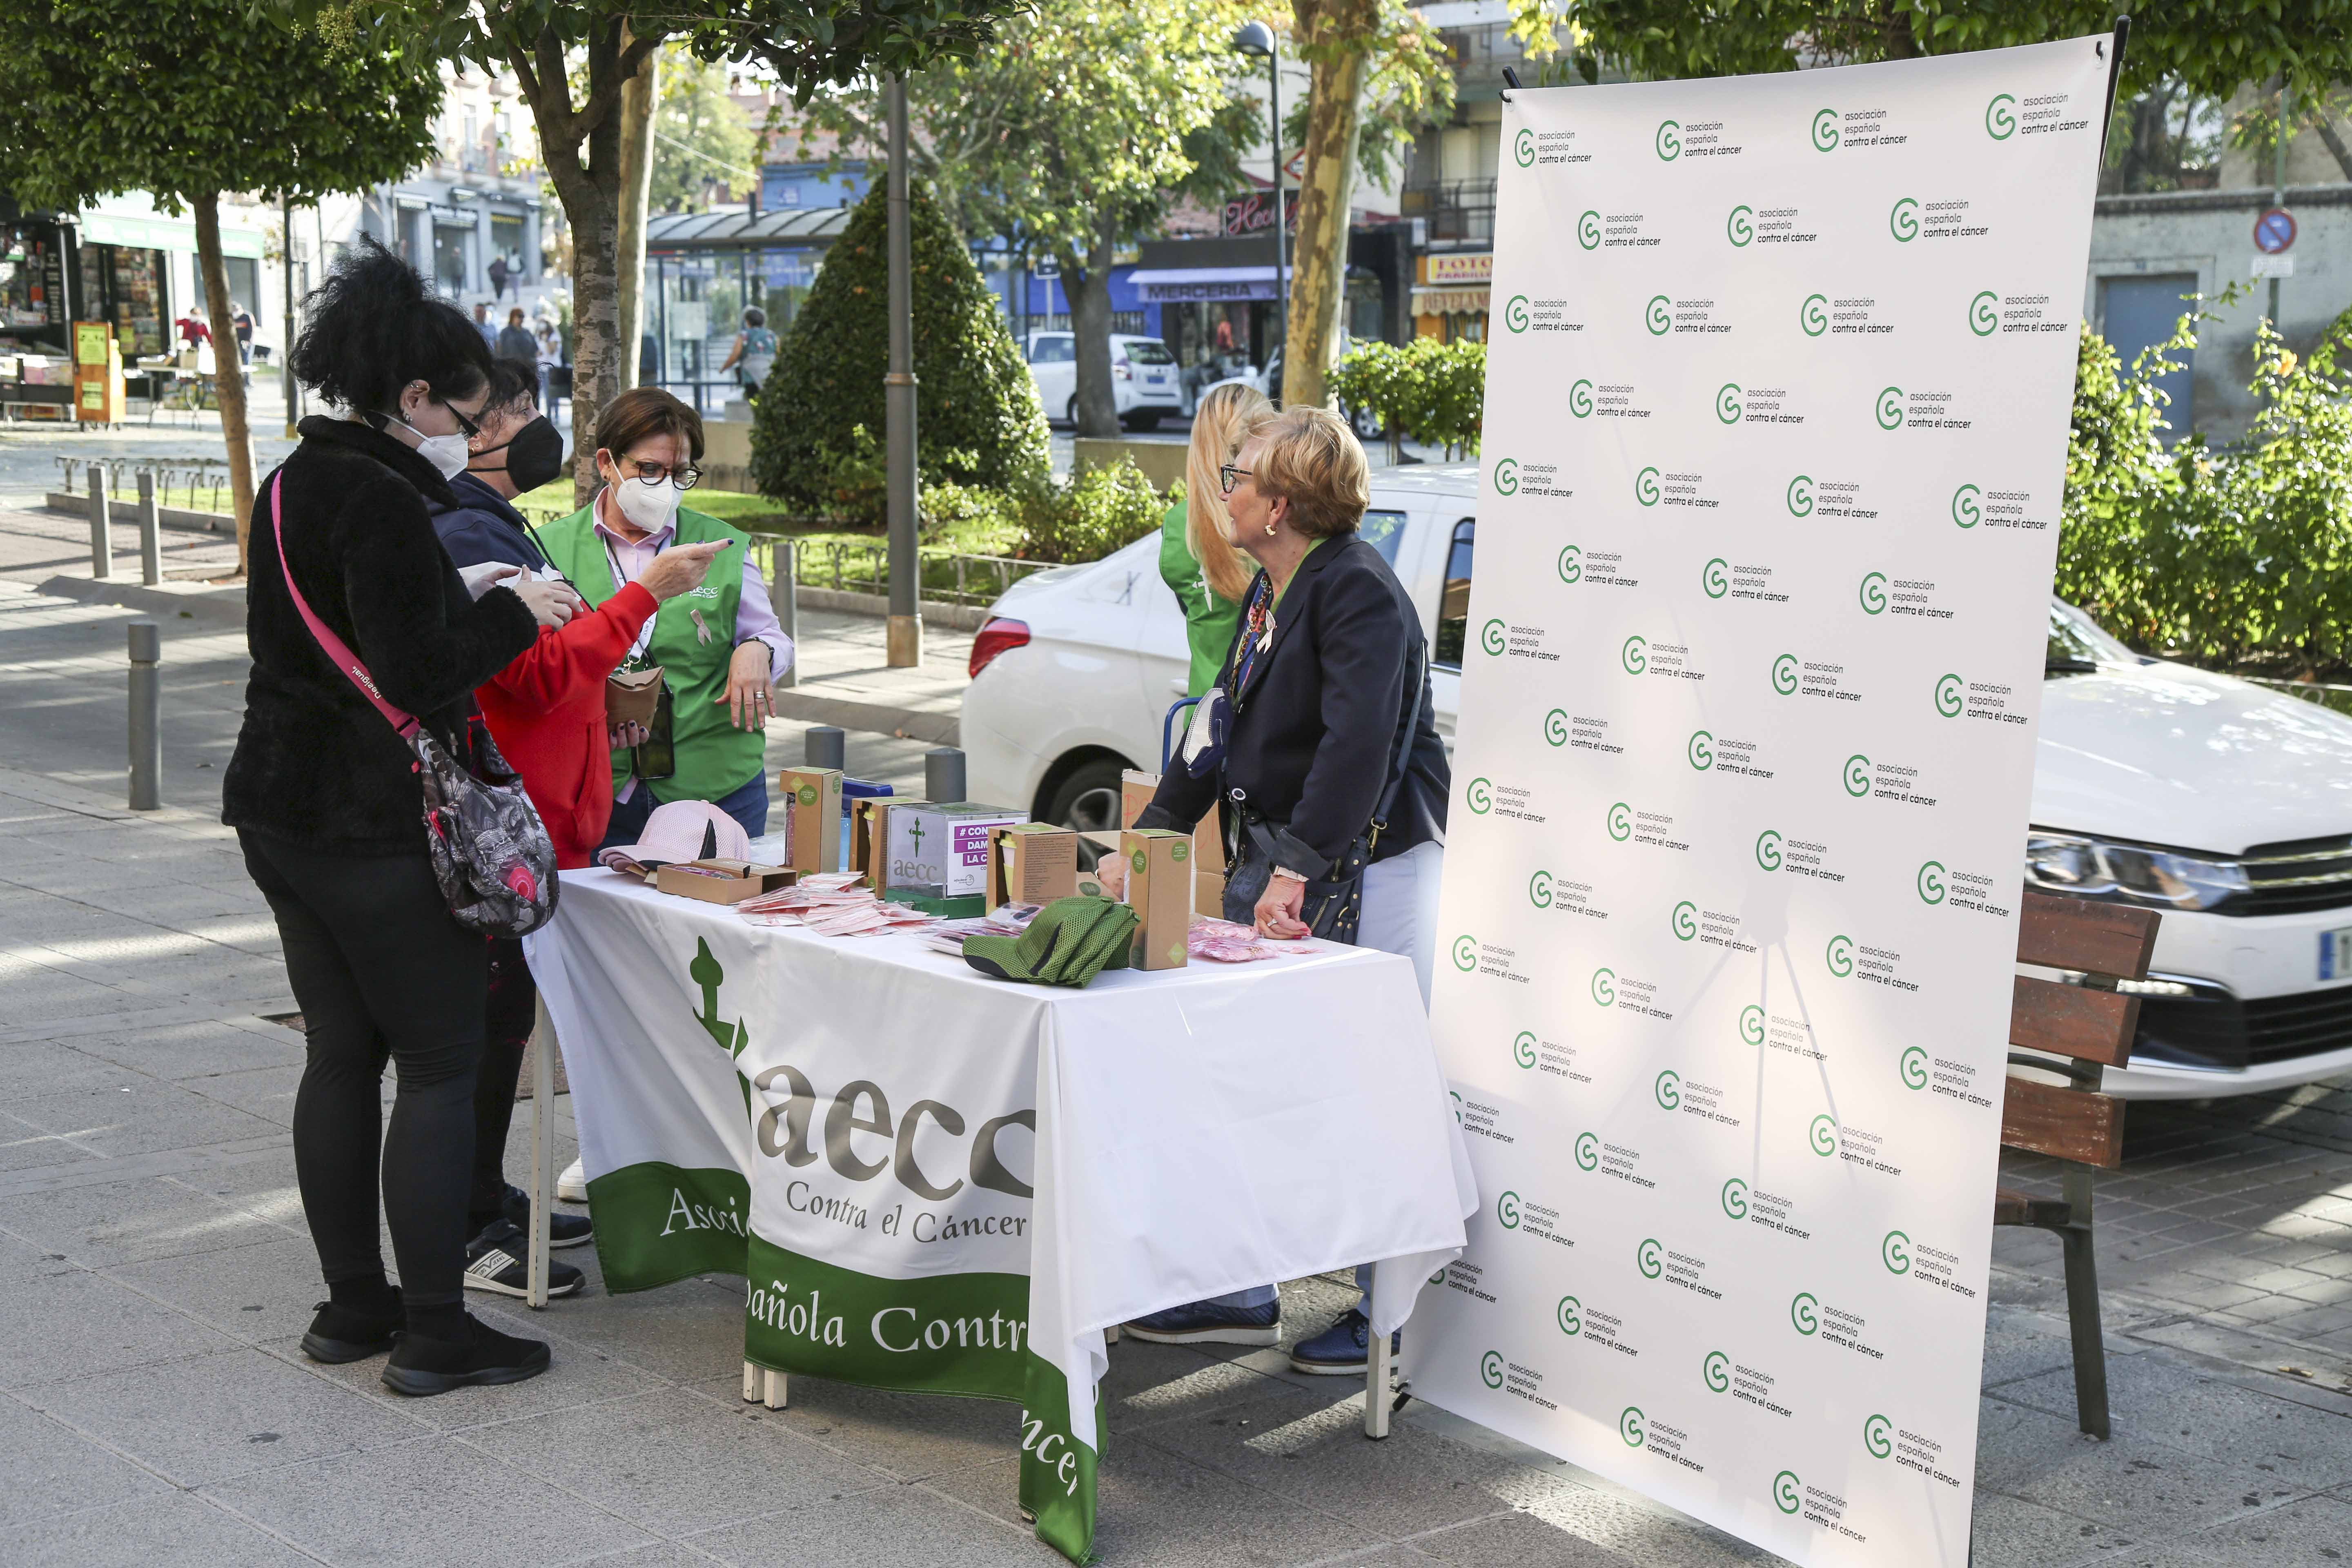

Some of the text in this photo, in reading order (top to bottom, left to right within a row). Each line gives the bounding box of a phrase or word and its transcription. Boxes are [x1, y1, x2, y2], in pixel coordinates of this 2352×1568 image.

[2023, 93, 2068, 107] asociación
[2022, 107, 2060, 122] española
[1686, 120, 1723, 132] asociación
[2021, 120, 2089, 134] contra el cáncer
[1686, 134, 1718, 146] española
[1685, 145, 1742, 157] contra el cáncer
[1759, 207, 1798, 218] asociación
[1758, 220, 1792, 232] española
[1757, 232, 1817, 243] contra el cáncer
[1534, 298, 1567, 307] asociación
[1677, 298, 1714, 308] asociación
[2005, 294, 2049, 305] asociación
[1533, 310, 1561, 321] española
[1676, 311, 1708, 322] española
[2004, 308, 2042, 321] española
[1532, 322, 1584, 331] contra el cáncer
[1675, 323, 1732, 332] contra el cáncer
[2003, 321, 2067, 332] contra el cáncer
[1910, 391, 1951, 401] asociación
[1909, 405, 1944, 416] española
[1908, 418, 1971, 428] contra el cáncer
[1666, 472, 1702, 482] asociación
[1664, 485, 1696, 495] española
[1987, 490, 2030, 501] asociación
[1664, 497, 1719, 508] contra el cáncer
[1986, 504, 2022, 516] española
[1985, 517, 2047, 530] contra el cáncer
[1586, 552, 1621, 562] asociación
[1586, 563, 1616, 573] española
[1585, 575, 1638, 587] contra el cáncer
[1893, 579, 1935, 590] asociación
[1892, 592, 1928, 603] española
[1891, 605, 1954, 619] contra el cáncer
[1804, 662, 1843, 674] asociación
[1803, 675, 1837, 686] española
[1802, 687, 1862, 702] contra el cáncer
[1970, 682, 2011, 695] asociación
[1969, 696, 2005, 708] española
[1967, 709, 2028, 725] contra el cáncer
[1719, 739, 1756, 751] asociación
[1718, 751, 1750, 762] española
[1717, 763, 1774, 779] contra el cáncer
[1637, 811, 1673, 824] asociación
[960, 828, 967, 837] #
[1636, 823, 1667, 835] española
[1635, 835, 1689, 851] contra el cáncer
[1788, 840, 1827, 853] asociación
[967, 855, 978, 864] LA
[1787, 852, 1820, 865] española
[894, 860, 938, 882] aecc
[1786, 864, 1845, 882] contra el cáncer
[1860, 946, 1900, 962] asociación
[1858, 958, 1893, 973] española
[1857, 971, 1919, 992] contra el cáncer
[1935, 1058, 1976, 1076] asociación
[1933, 1071, 1969, 1087] española
[1932, 1085, 1992, 1108] contra el cáncer
[754, 1065, 1036, 1200] aecc
[1604, 1143, 1639, 1160] asociación
[1603, 1155, 1633, 1170] española
[1601, 1166, 1655, 1189] contra el cáncer
[786, 1180, 1027, 1243] Contra el Cáncer
[493, 1256, 505, 1265] JEANS
[1917, 1244, 1959, 1265] asociación
[1916, 1257, 1952, 1276] española
[1914, 1270, 1976, 1298] contra el cáncer
[746, 1279, 847, 1348] añola
[1824, 1306, 1865, 1327] asociación
[1823, 1319, 1858, 1337] española
[1822, 1331, 1884, 1359] contra el cáncer
[1509, 1363, 1543, 1381] asociación
[1735, 1365, 1774, 1385] asociación
[1508, 1374, 1537, 1391] española
[1734, 1377, 1768, 1395] española
[1506, 1385, 1557, 1411] contra el cáncer
[1733, 1389, 1792, 1418] contra el cáncer
[1899, 1430, 1942, 1453] asociación
[1898, 1443, 1934, 1463] española
[1896, 1455, 1960, 1488] contra el cáncer
